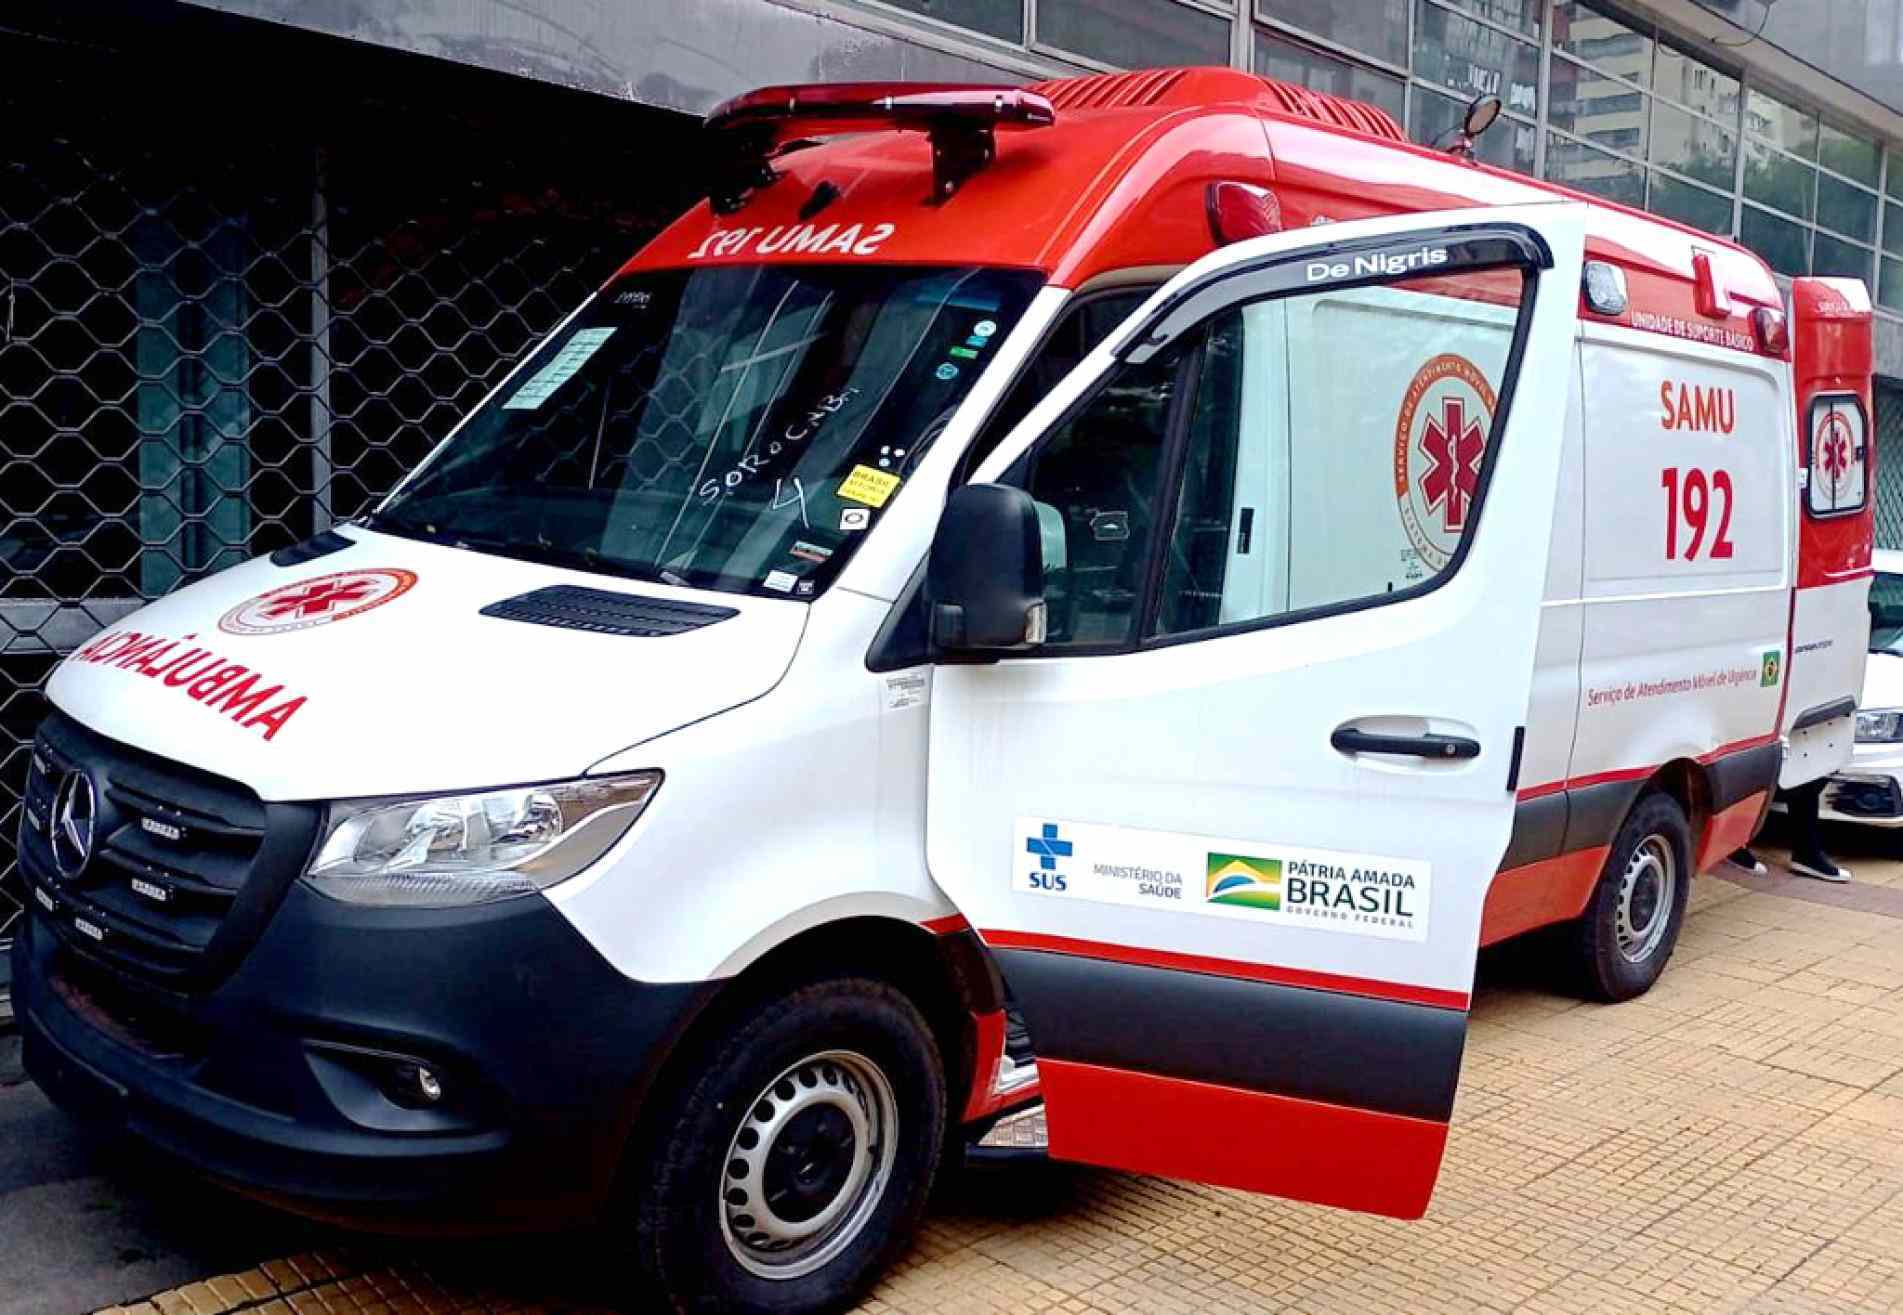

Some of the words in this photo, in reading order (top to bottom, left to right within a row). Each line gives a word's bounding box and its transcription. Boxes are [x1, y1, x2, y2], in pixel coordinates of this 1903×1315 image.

[1306, 263, 1350, 281] De
[1354, 246, 1447, 275] Nigris
[1661, 380, 1735, 433] SAMU
[772, 478, 809, 528] 4
[1662, 468, 1733, 561] 192
[1588, 687, 1621, 706] Serviço
[1624, 682, 1634, 699] de
[1638, 679, 1691, 697] Atendimento
[1029, 872, 1067, 891] SUS
[1093, 863, 1163, 884] MINISTÉRIO
[1165, 871, 1183, 885] DA
[1288, 859, 1346, 880] PÁTRIA
[1351, 868, 1415, 889] AMADA
[1139, 882, 1182, 899] SAÚDE
[1287, 877, 1414, 917] BRASIL
[1287, 905, 1348, 921] GOVERNO
[1354, 914, 1414, 929] FEDERAL
